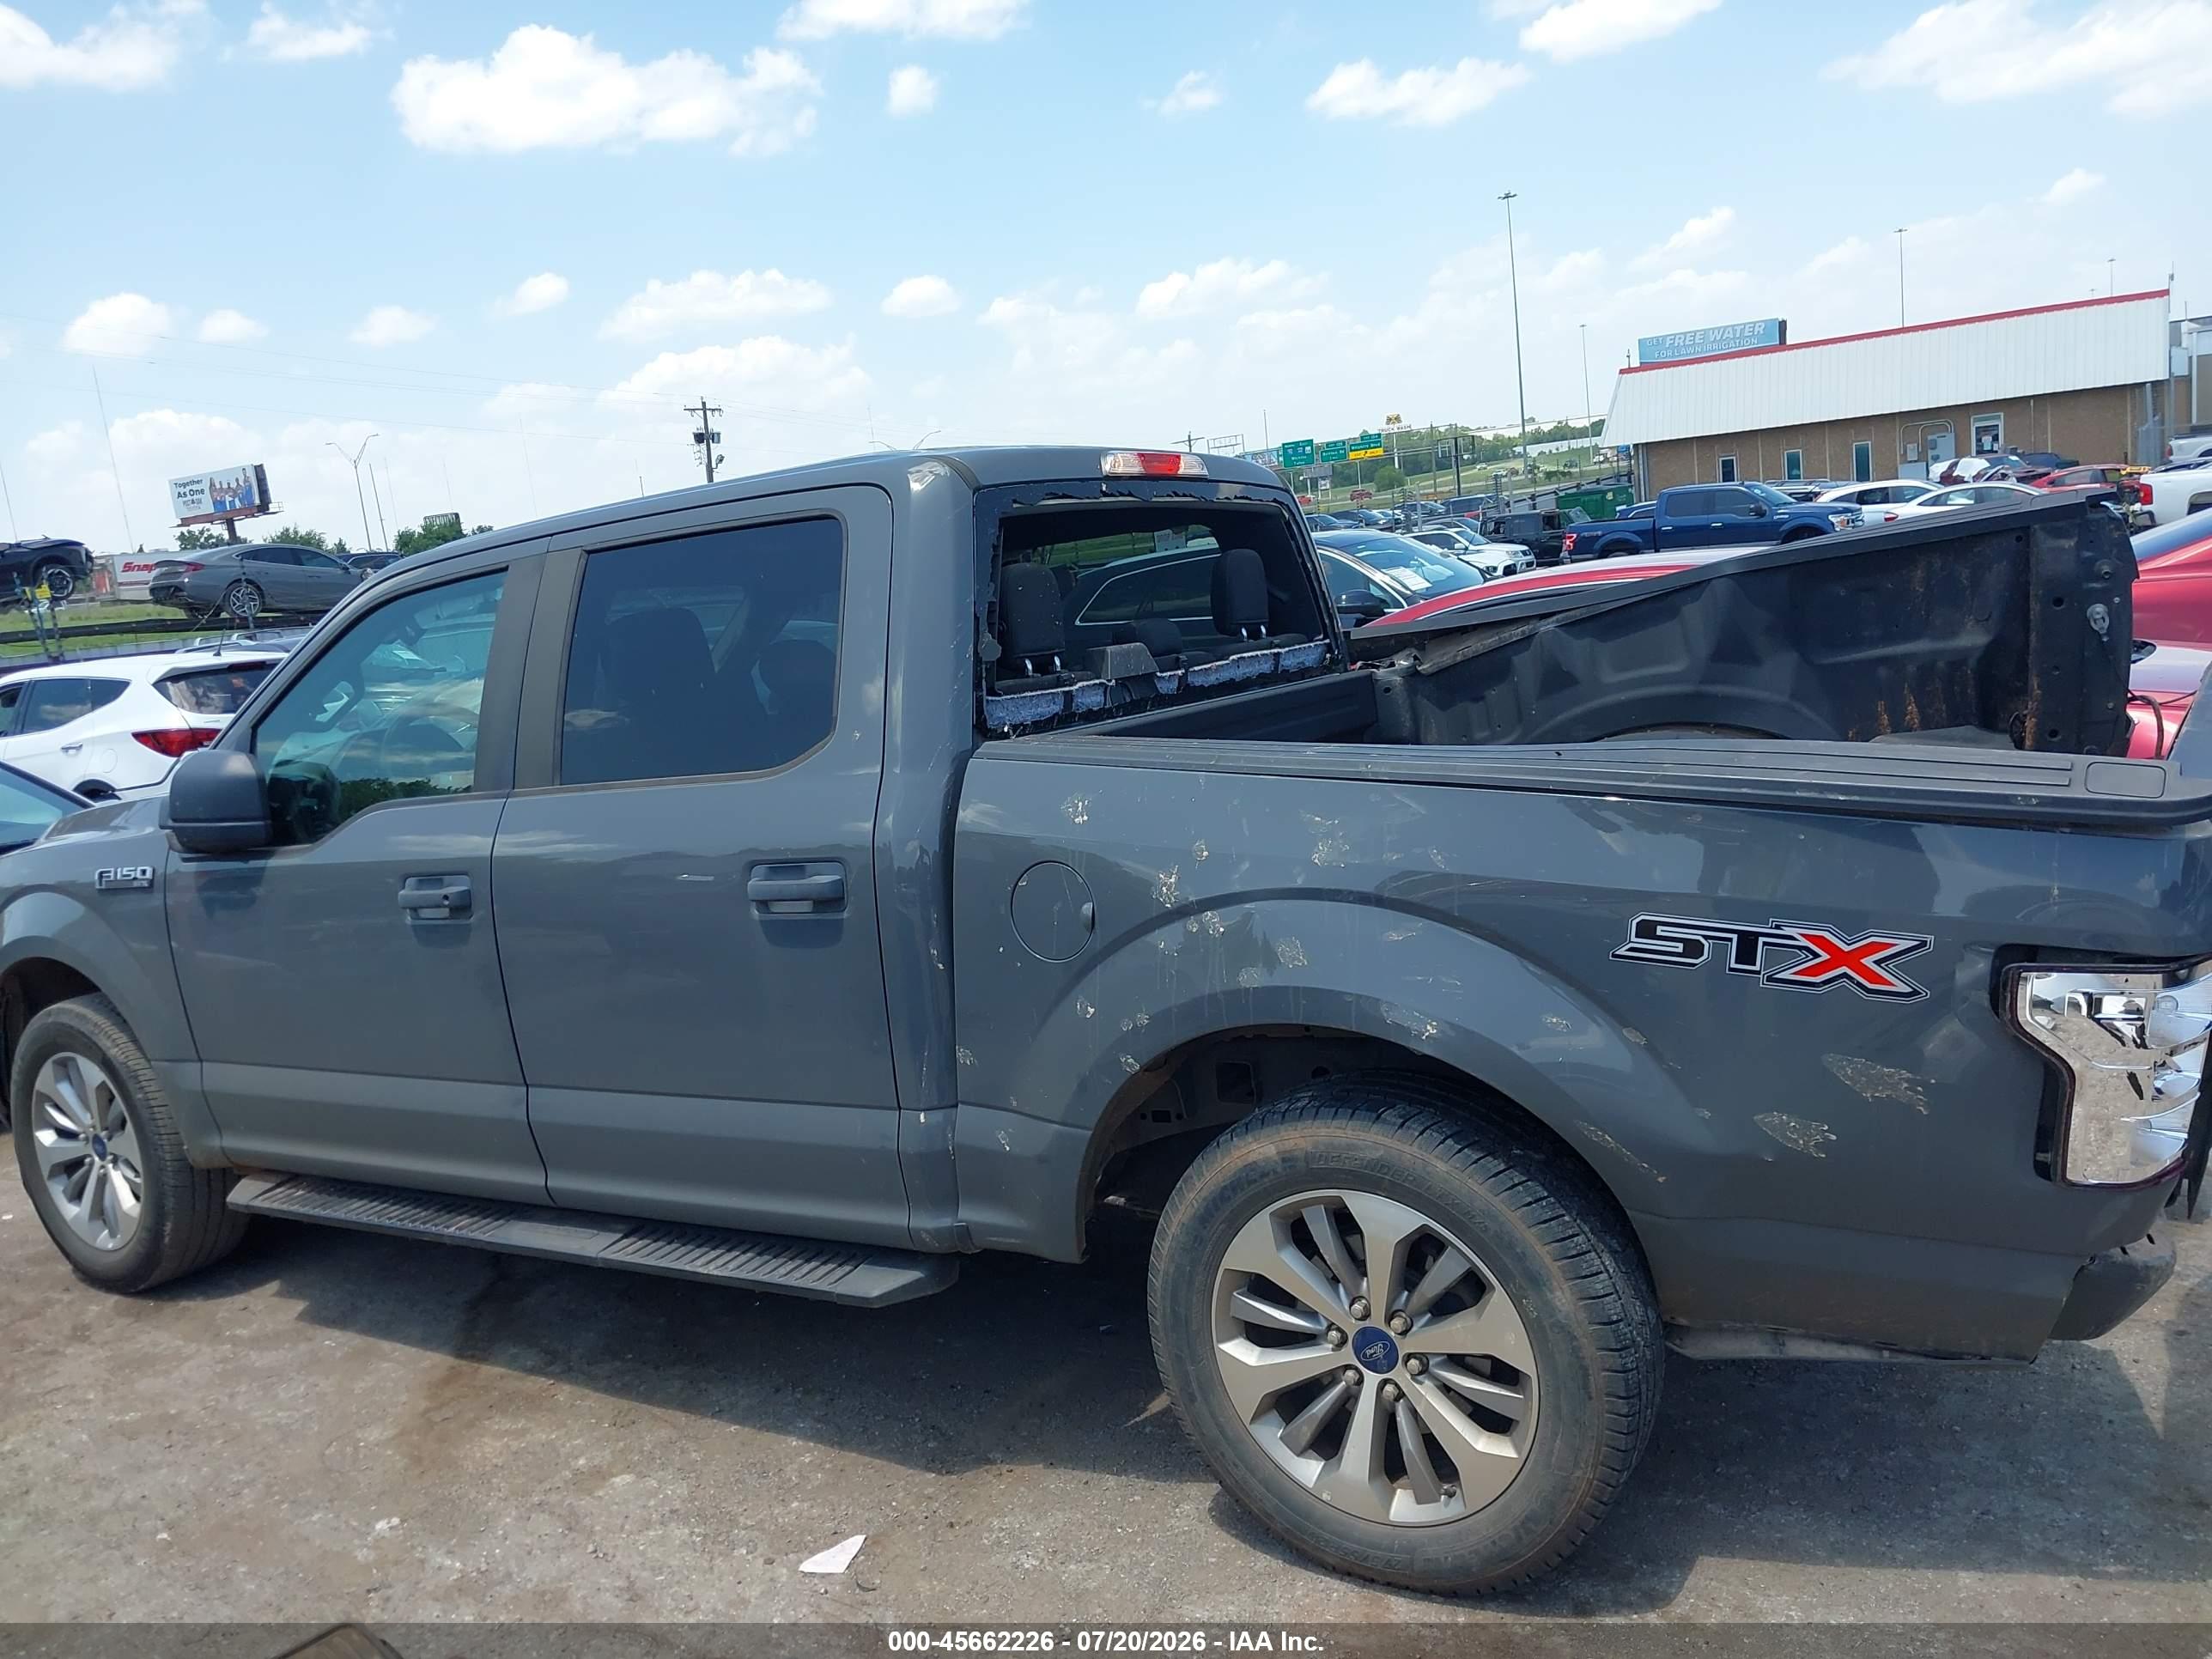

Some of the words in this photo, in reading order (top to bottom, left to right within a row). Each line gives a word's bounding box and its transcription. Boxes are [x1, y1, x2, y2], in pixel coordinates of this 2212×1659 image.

[1647, 337, 1663, 346] GET
[1665, 331, 1705, 348] FREE
[1709, 322, 1765, 341] WATER
[1655, 349, 1673, 359] FOR
[1675, 346, 1702, 356] LAWN
[1704, 338, 1758, 352] IRRIGATION
[173, 478, 203, 489] Together
[177, 491, 188, 500] As
[189, 488, 205, 497] One
[1609, 911, 1935, 1004] STX
